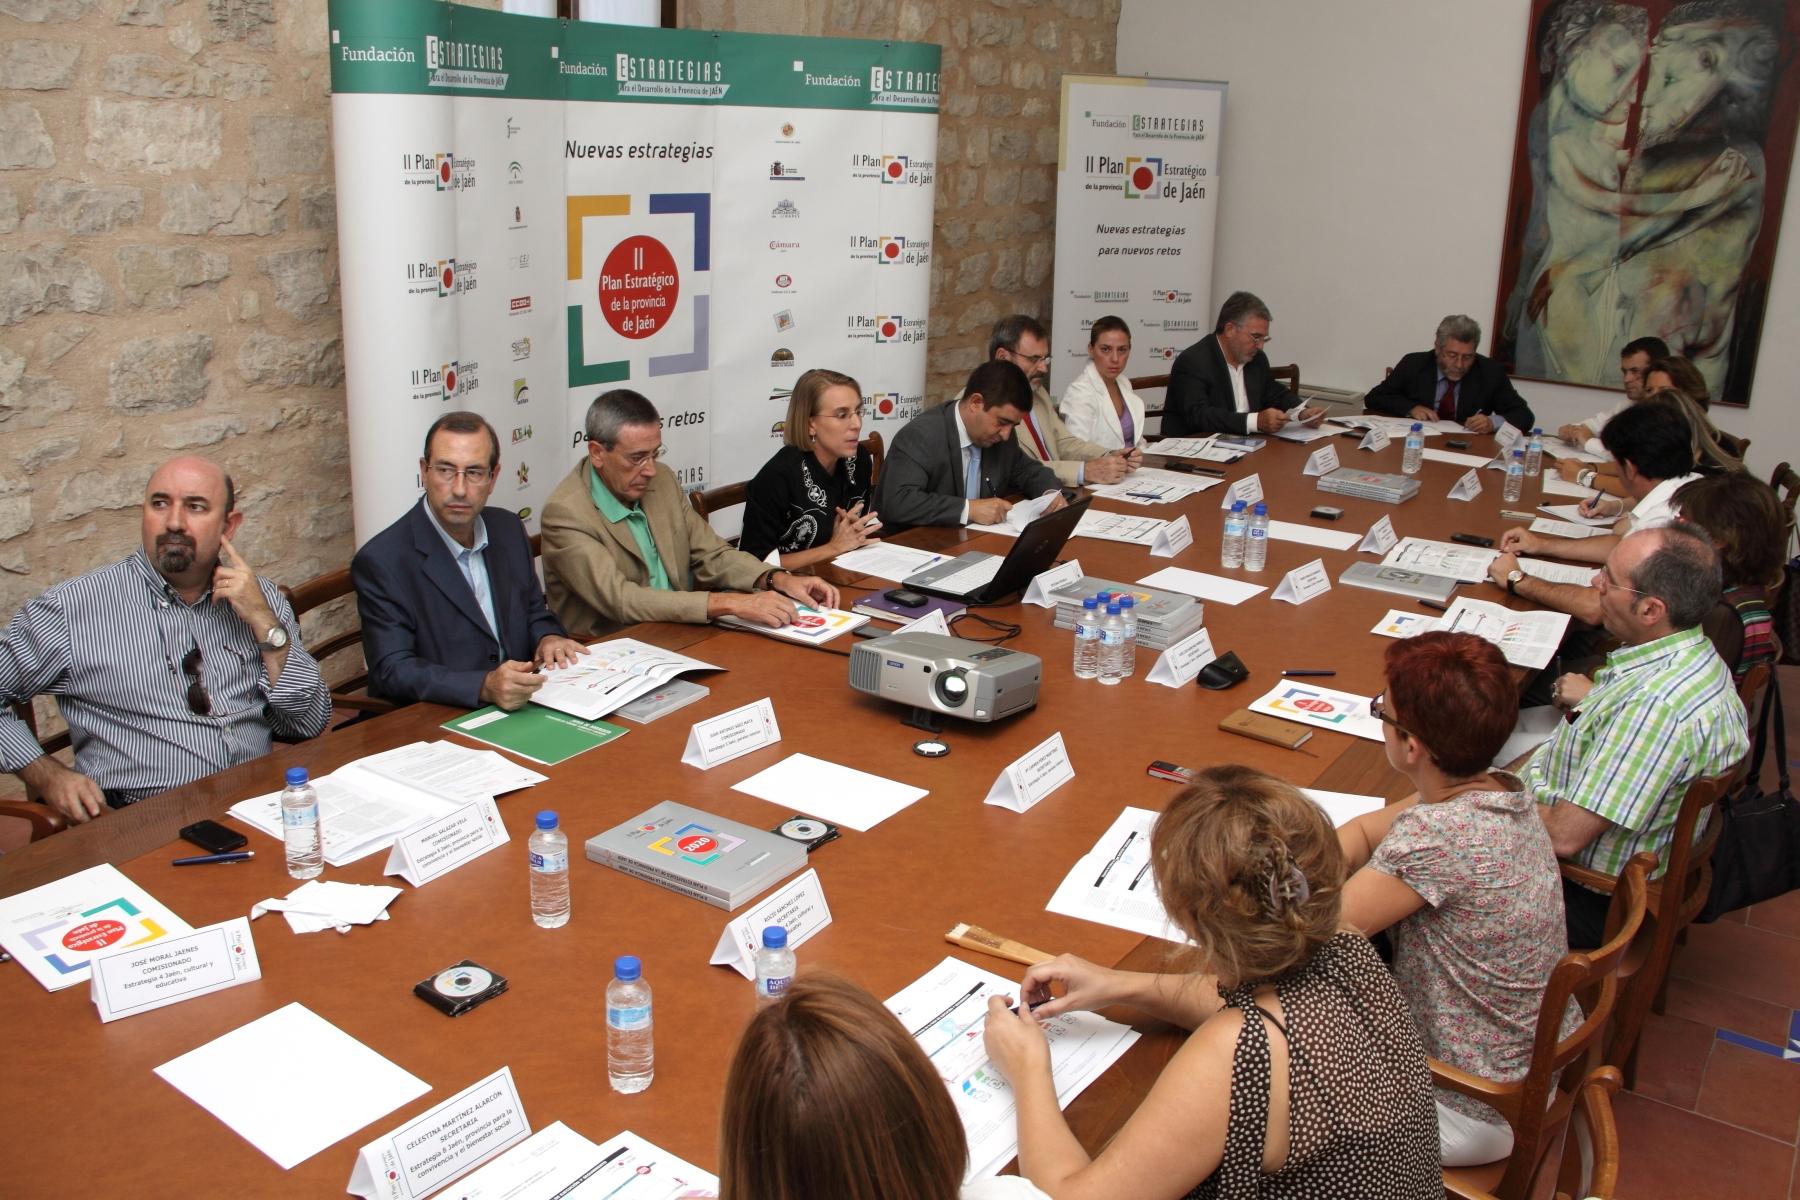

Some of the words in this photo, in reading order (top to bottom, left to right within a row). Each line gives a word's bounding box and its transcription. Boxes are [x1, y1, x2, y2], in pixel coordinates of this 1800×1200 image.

[341, 46, 416, 63] Fundación
[426, 36, 503, 70] ESTRATEGIAS
[559, 61, 608, 76] Fundación
[616, 54, 722, 82] ESTRATEGIAS
[805, 73, 861, 87] Fundación
[1092, 118, 1127, 129] Fundación
[1132, 114, 1204, 132] ESTRATEGIAS
[565, 140, 623, 159] Nuevas
[629, 141, 714, 163] estrategias
[853, 154, 859, 166] II
[862, 154, 881, 167] Plan
[404, 154, 411, 169] II
[416, 154, 435, 170] Plan
[1086, 155, 1094, 173] II
[1099, 156, 1124, 174] Plan
[1164, 163, 1207, 180] Estratégico
[461, 173, 476, 192] Jaén
[909, 172, 918, 184] de
[1099, 183, 1123, 191] provincia
[1163, 181, 1177, 199] de
[1179, 181, 1206, 203] Jaén
[1096, 223, 1130, 235] Nuevas
[1132, 224, 1186, 237] estrategias
[850, 236, 857, 248] II
[860, 236, 878, 248] Plan
[634, 247, 644, 270] II
[905, 252, 915, 264] de
[1098, 246, 1119, 258] para
[1121, 247, 1154, 256] nuevos
[1156, 246, 1181, 256] retos
[408, 264, 414, 279] II
[419, 263, 438, 278] Plan
[463, 276, 477, 295] Jaén
[602, 275, 623, 291] Plan
[625, 271, 675, 292] Estratégico
[611, 297, 622, 312] de
[623, 296, 630, 310] la
[631, 295, 666, 313] provincia
[623, 317, 634, 332] de
[635, 315, 655, 335] Jaén
[848, 316, 854, 327] II
[857, 316, 875, 327] Plan
[902, 331, 912, 342] de
[424, 369, 441, 385] Plan
[466, 378, 479, 396] Jaén
[668, 411, 705, 428] retos
[900, 407, 909, 418] de
[432, 828, 462, 847] COMISIONADO
[438, 823, 457, 837] SALAZAR
[683, 837, 711, 852] 2020
[131, 958, 148, 968] JOSÉ
[149, 952, 173, 965] MORAL
[174, 945, 199, 958] JAENES
[142, 957, 192, 975] COMISIONADO
[124, 975, 158, 990] Estrategia
[183, 961, 208, 975] cultural
[155, 976, 187, 989] educativa
[406, 1129, 442, 1151] CELESTINA
[442, 1107, 474, 1130] MARTÍNEZ
[475, 1090, 503, 1111] ALARCÓN
[410, 1152, 442, 1173] Estrategia
[448, 1139, 465, 1152] Jaén,
[465, 1123, 492, 1141] provincia
[492, 1112, 507, 1127] para
[507, 1108, 513, 1116] la
[417, 1154, 454, 1179] convivencia
[454, 1150, 459, 1158] y
[466, 1131, 493, 1149] bienestar
[494, 1118, 512, 1134] social
